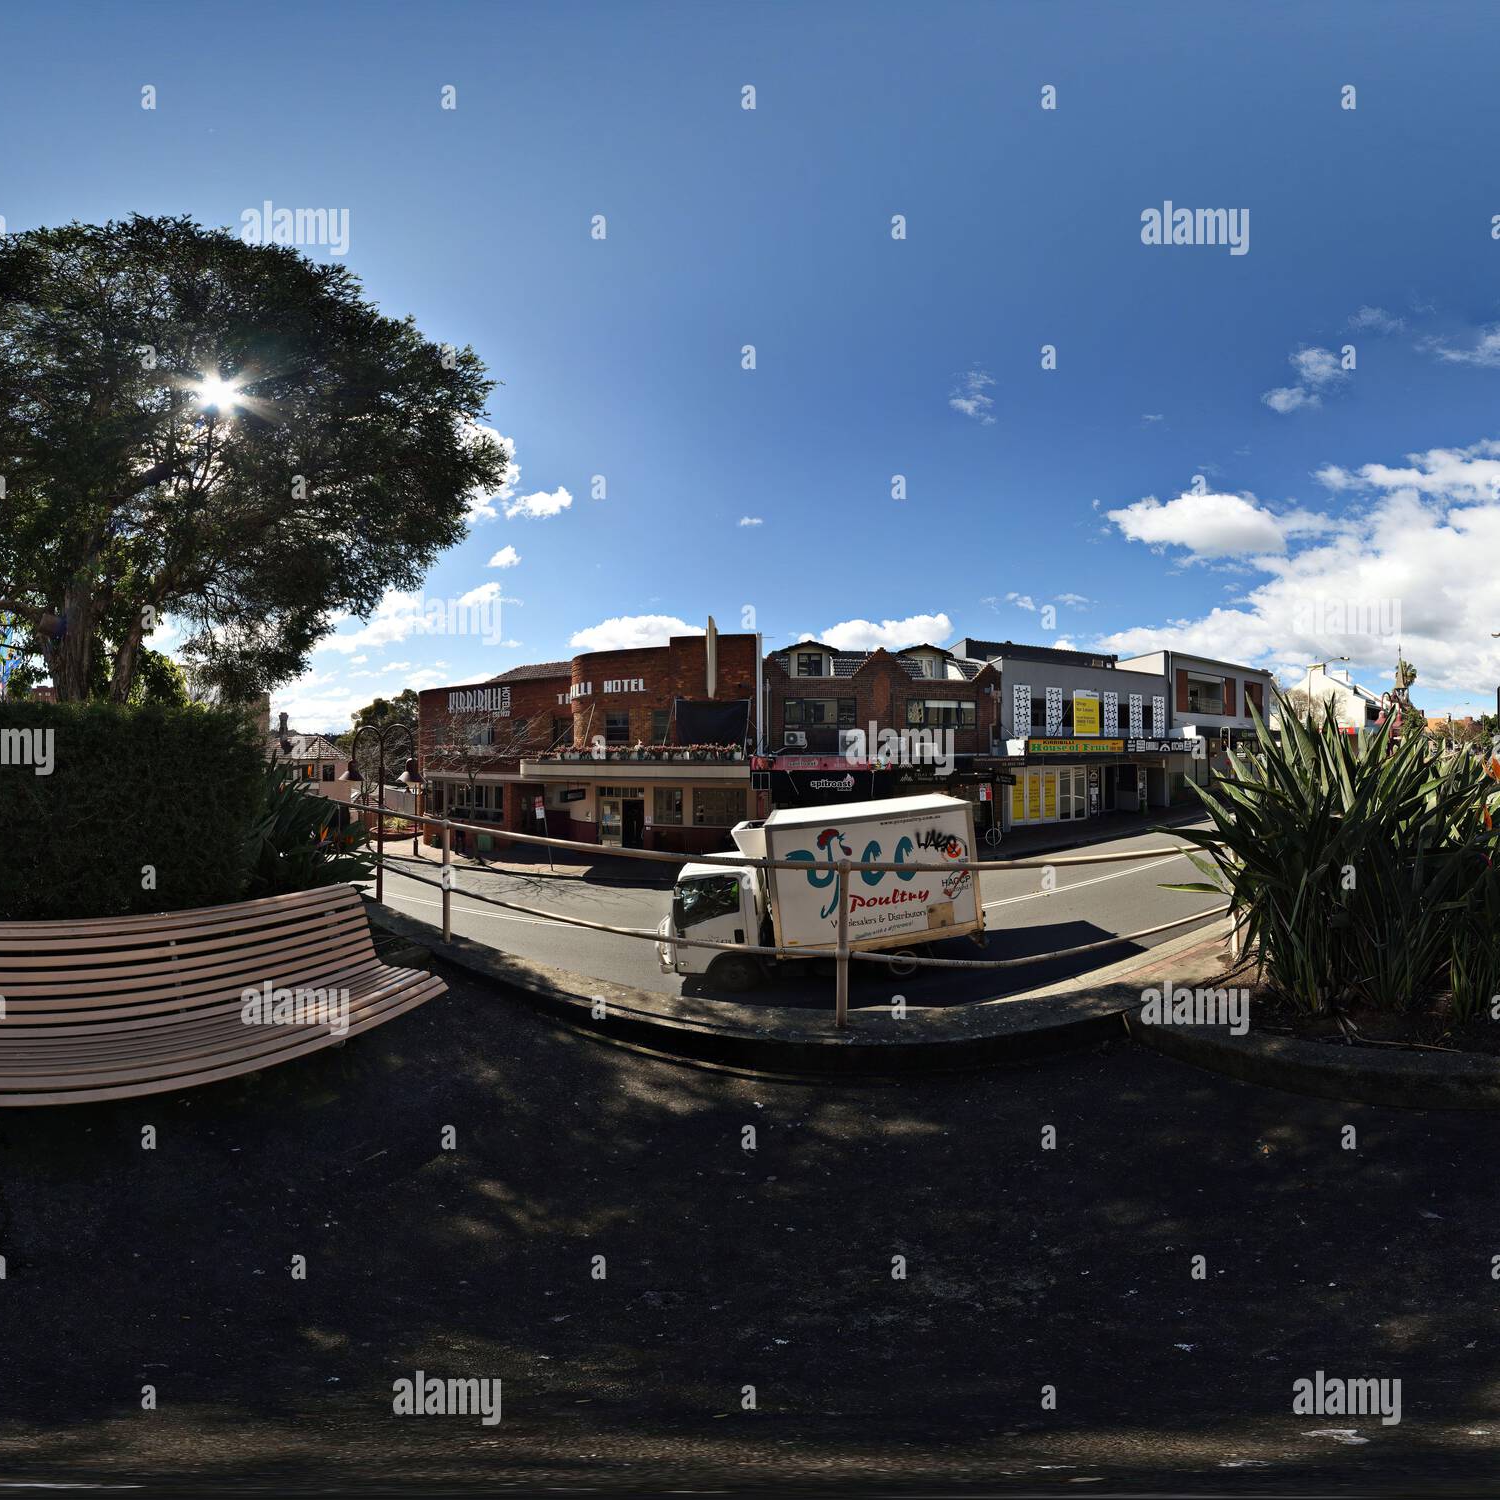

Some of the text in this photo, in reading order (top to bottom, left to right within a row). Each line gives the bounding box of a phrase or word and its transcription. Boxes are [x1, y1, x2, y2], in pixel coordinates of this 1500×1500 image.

[603, 678, 647, 693] HOTEL
[1031, 743, 1067, 752] House
[1069, 743, 1079, 751] of
[810, 778, 853, 789] spitroast
[849, 888, 930, 913] Poultry
[879, 915, 885, 923] &
[888, 910, 927, 921] Distributors
